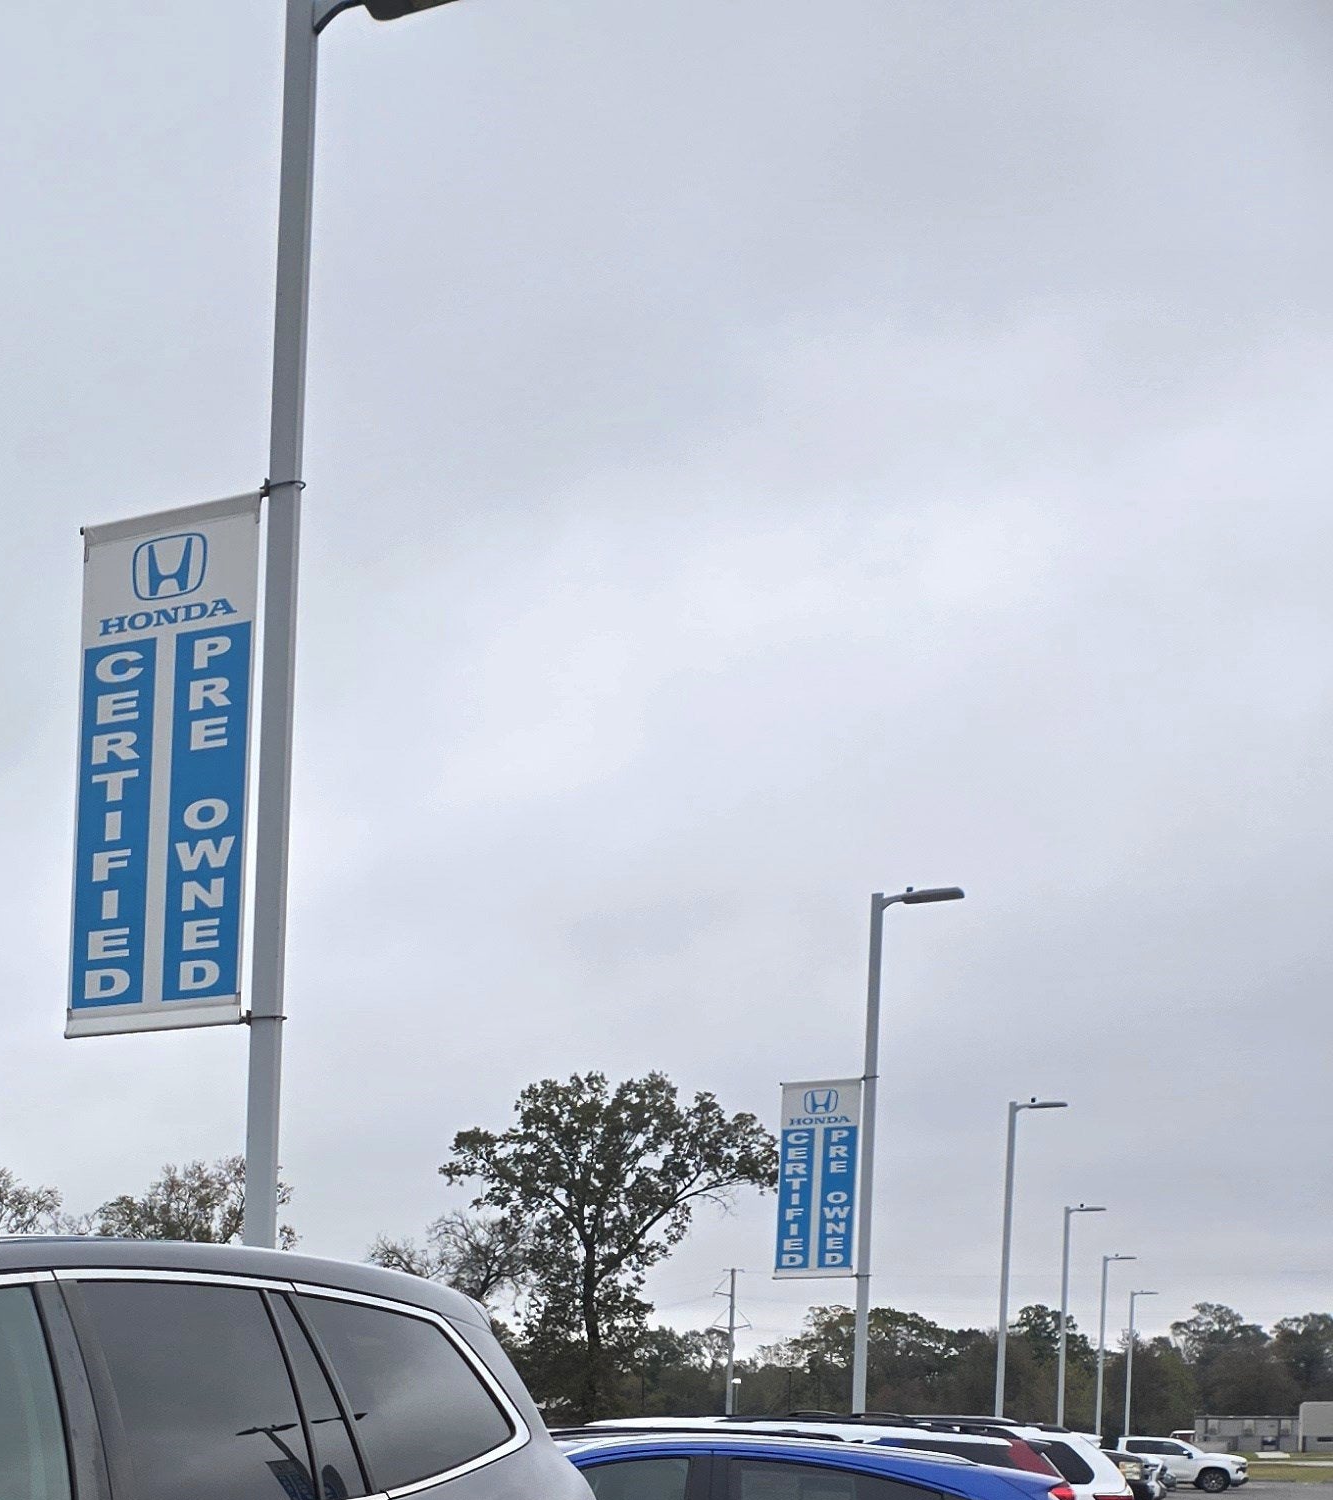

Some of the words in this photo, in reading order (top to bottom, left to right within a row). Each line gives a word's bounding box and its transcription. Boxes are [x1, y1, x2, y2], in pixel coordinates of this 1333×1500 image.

[99, 598, 237, 637] HONDA
[188, 635, 232, 752] PRE
[84, 650, 144, 1001] CERTIFIED
[175, 798, 236, 992] OWNED
[789, 1116, 851, 1126] HONDA
[829, 1130, 849, 1174] PRE
[781, 1131, 810, 1267] CERTIFIED
[823, 1191, 850, 1265] OWNED
